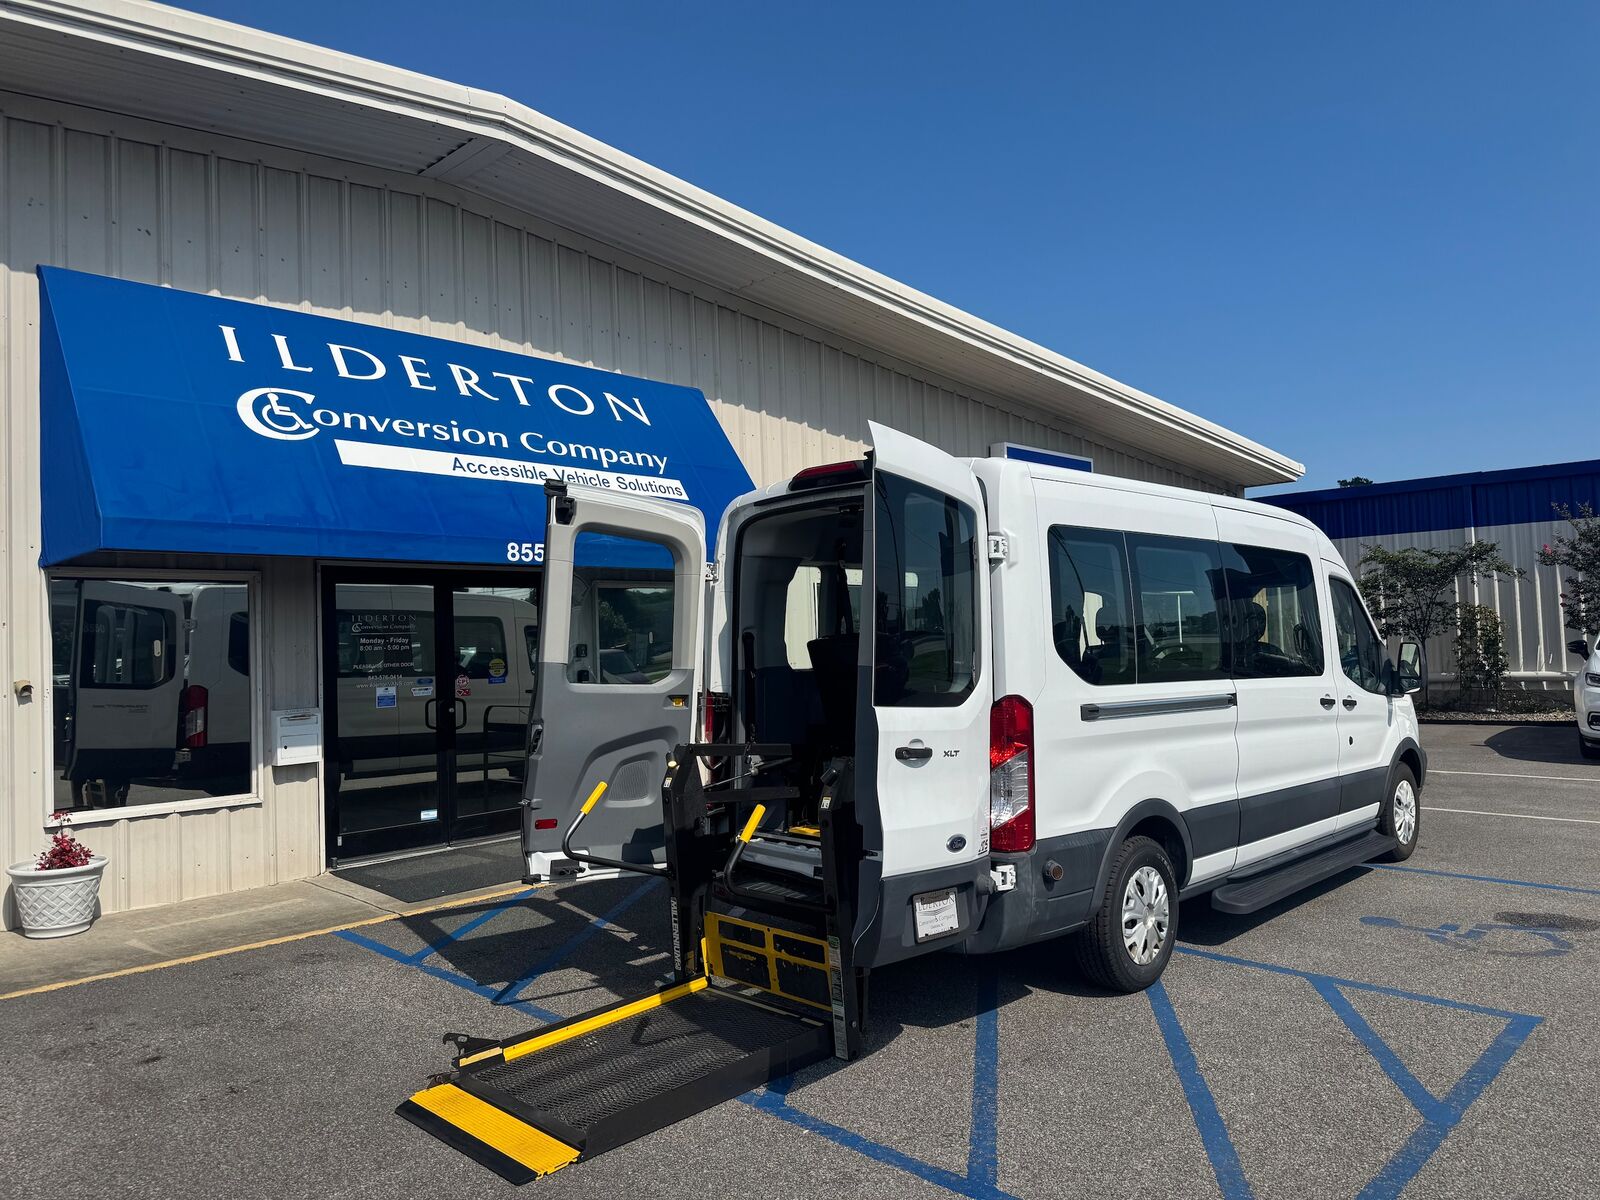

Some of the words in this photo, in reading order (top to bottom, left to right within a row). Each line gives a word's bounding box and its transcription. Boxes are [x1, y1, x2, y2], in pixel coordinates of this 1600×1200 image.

[218, 325, 652, 426] ILDERTON
[236, 387, 509, 448] Conversion
[520, 431, 668, 475] Company
[452, 456, 548, 481] Accessible
[552, 467, 611, 488] Vehicle
[616, 476, 683, 497] Solutions
[390, 636, 409, 644] Friday
[943, 750, 960, 758] XLT
